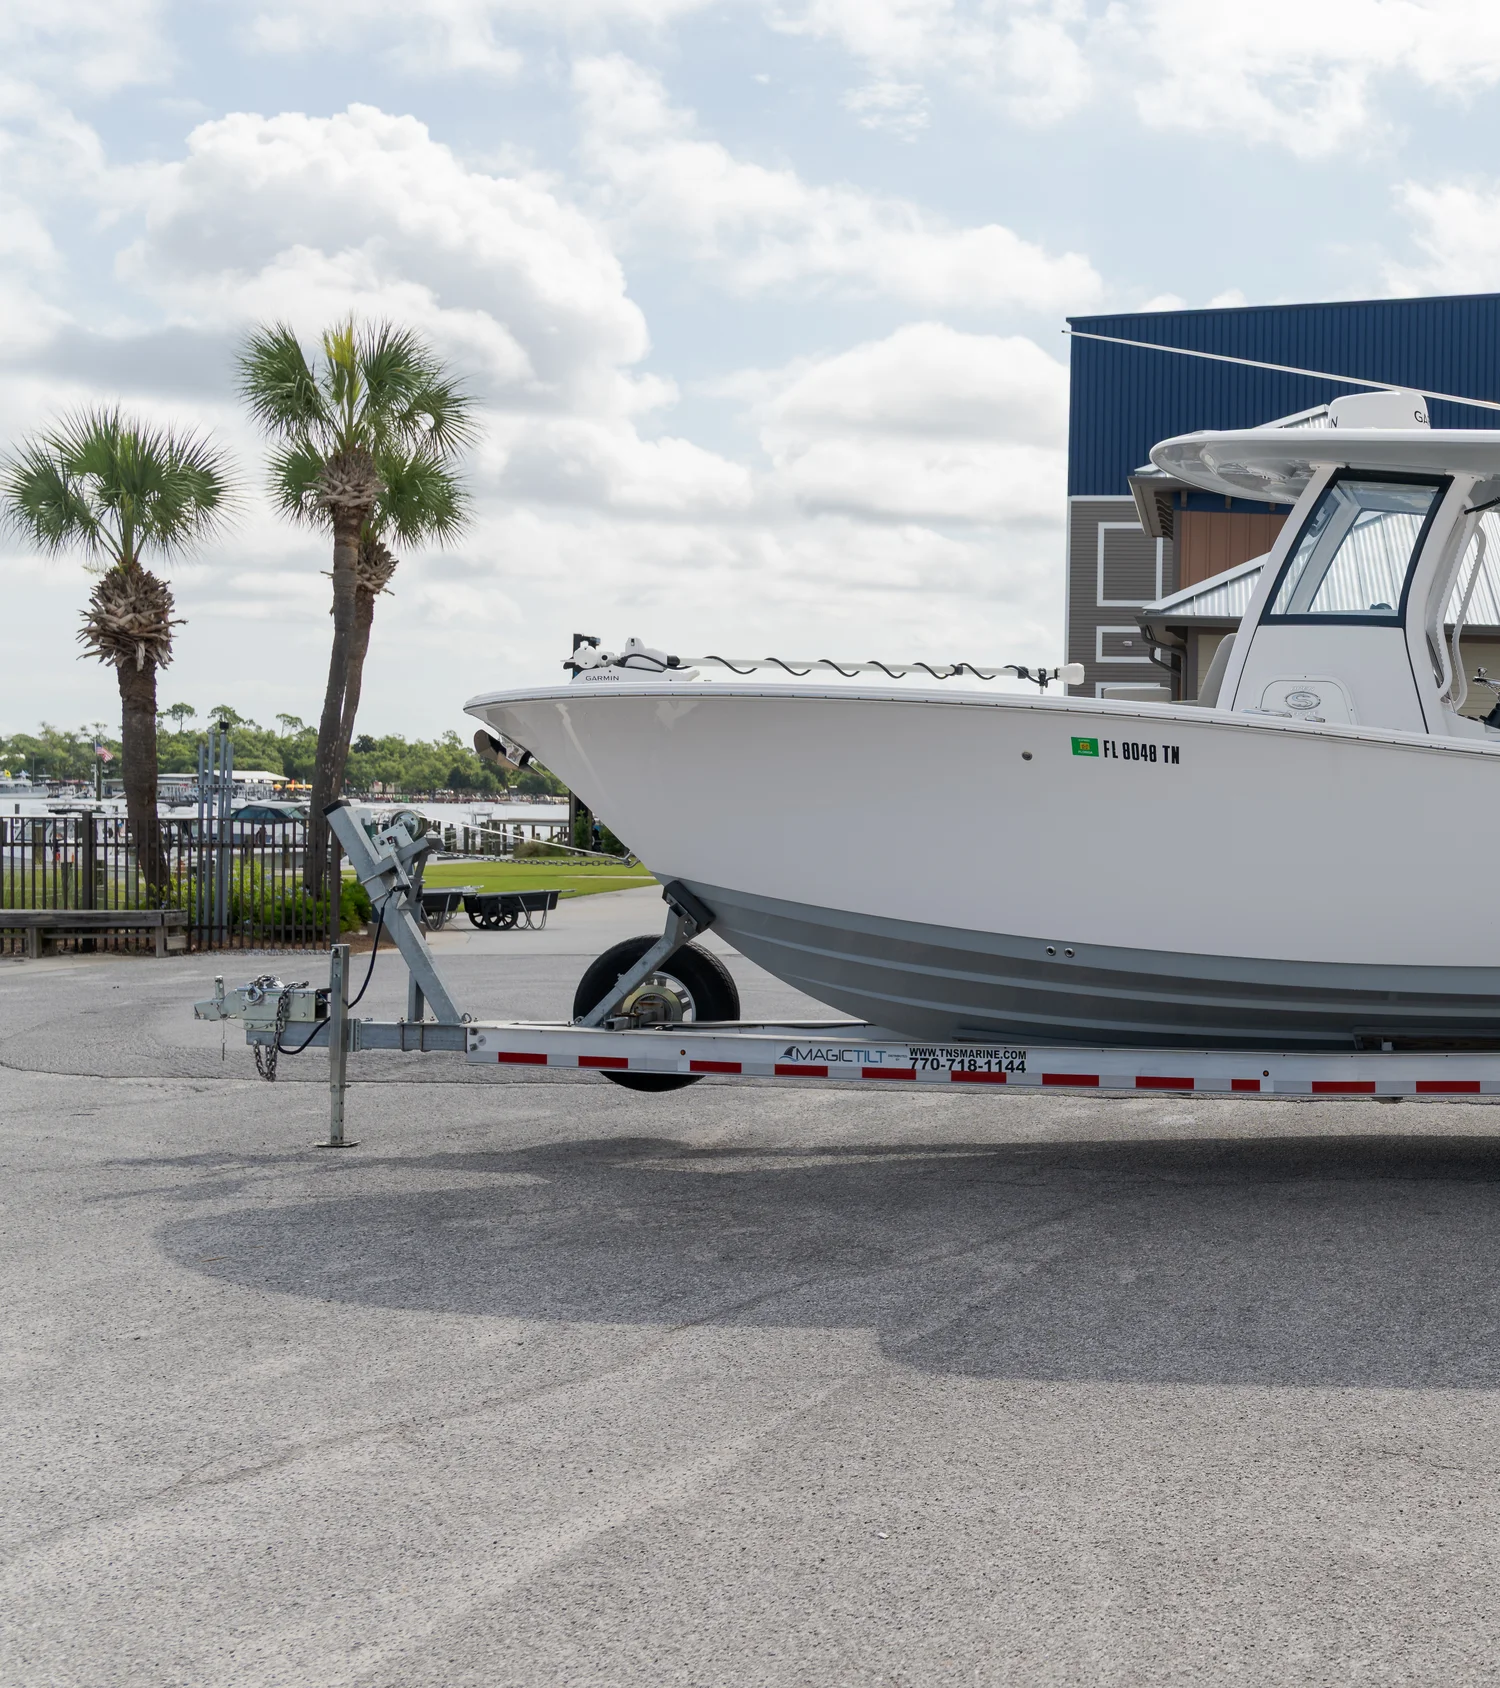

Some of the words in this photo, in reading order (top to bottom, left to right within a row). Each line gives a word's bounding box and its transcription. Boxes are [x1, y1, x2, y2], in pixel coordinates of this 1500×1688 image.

[1103, 740, 1119, 759] FL
[1122, 742, 1157, 763] 8048
[1162, 745, 1180, 764] TN
[796, 1048, 887, 1063] MAGICTILT
[909, 1047, 1027, 1060] WWW.TNSMARINE.COM
[909, 1057, 1026, 1073] 770-718-1144
